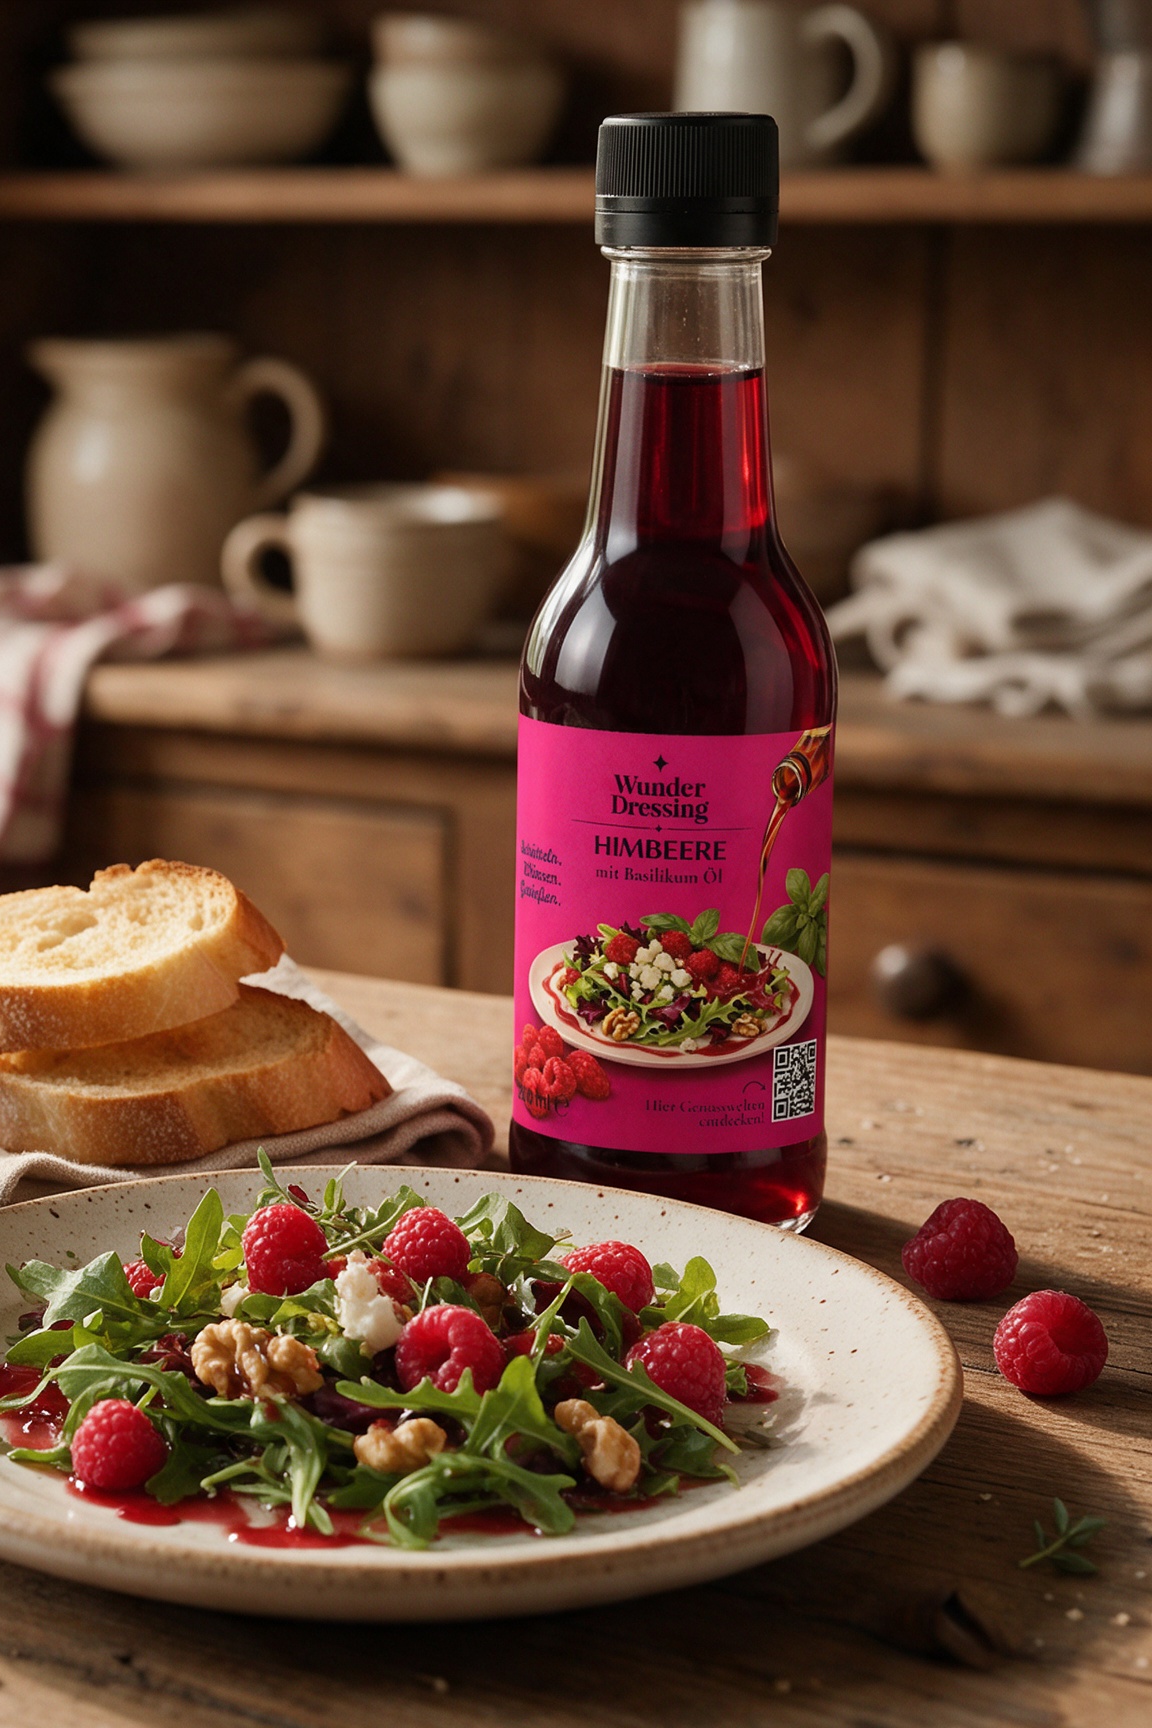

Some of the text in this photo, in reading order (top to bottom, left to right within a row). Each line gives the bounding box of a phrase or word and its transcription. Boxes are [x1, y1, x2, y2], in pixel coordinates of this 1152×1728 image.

[614, 774, 706, 798] Wunder
[611, 794, 709, 825] Dressing
[594, 835, 727, 861] HIMBEERE
[596, 865, 723, 884] mit Basilikum Öl
[646, 1100, 676, 1112] Hier
